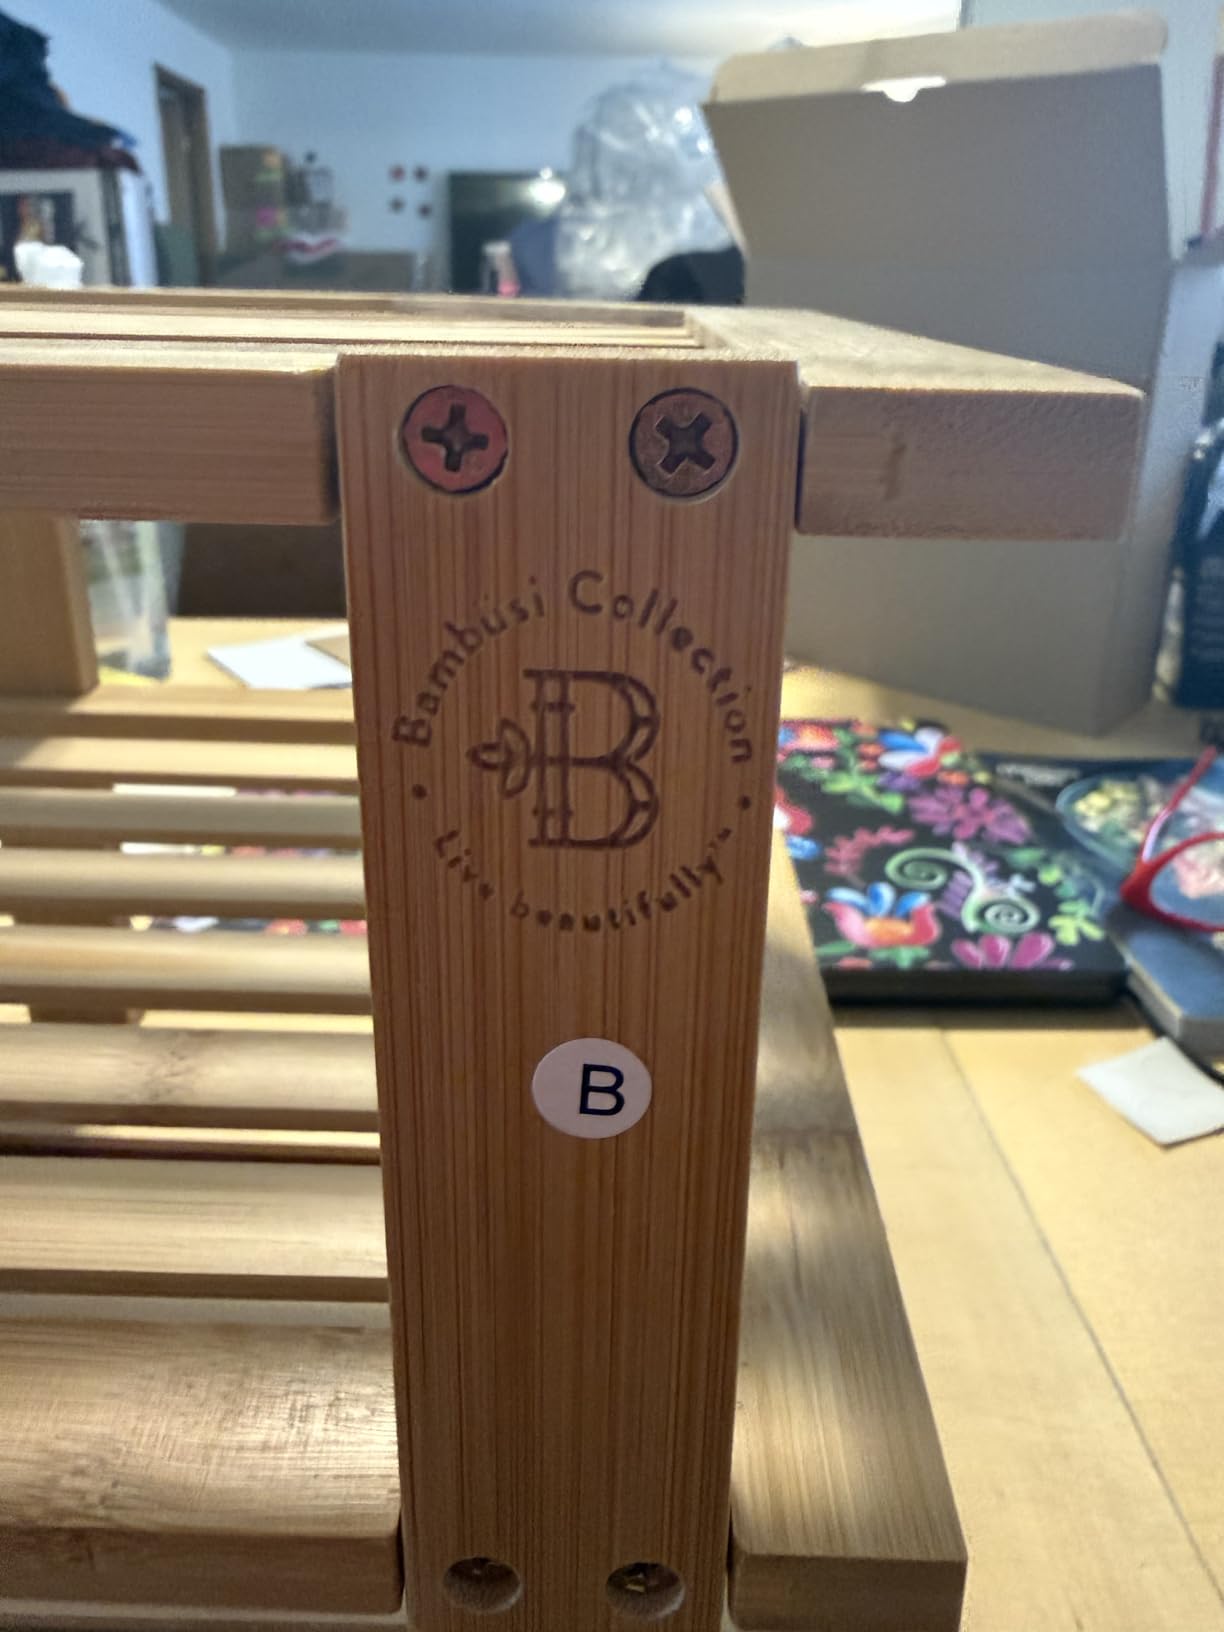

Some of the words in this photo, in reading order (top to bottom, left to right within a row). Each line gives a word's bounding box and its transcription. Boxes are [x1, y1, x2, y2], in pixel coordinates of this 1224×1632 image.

[566, 569, 754, 765] Collection
[433, 829, 495, 902] Live
[579, 1062, 626, 1117] B
